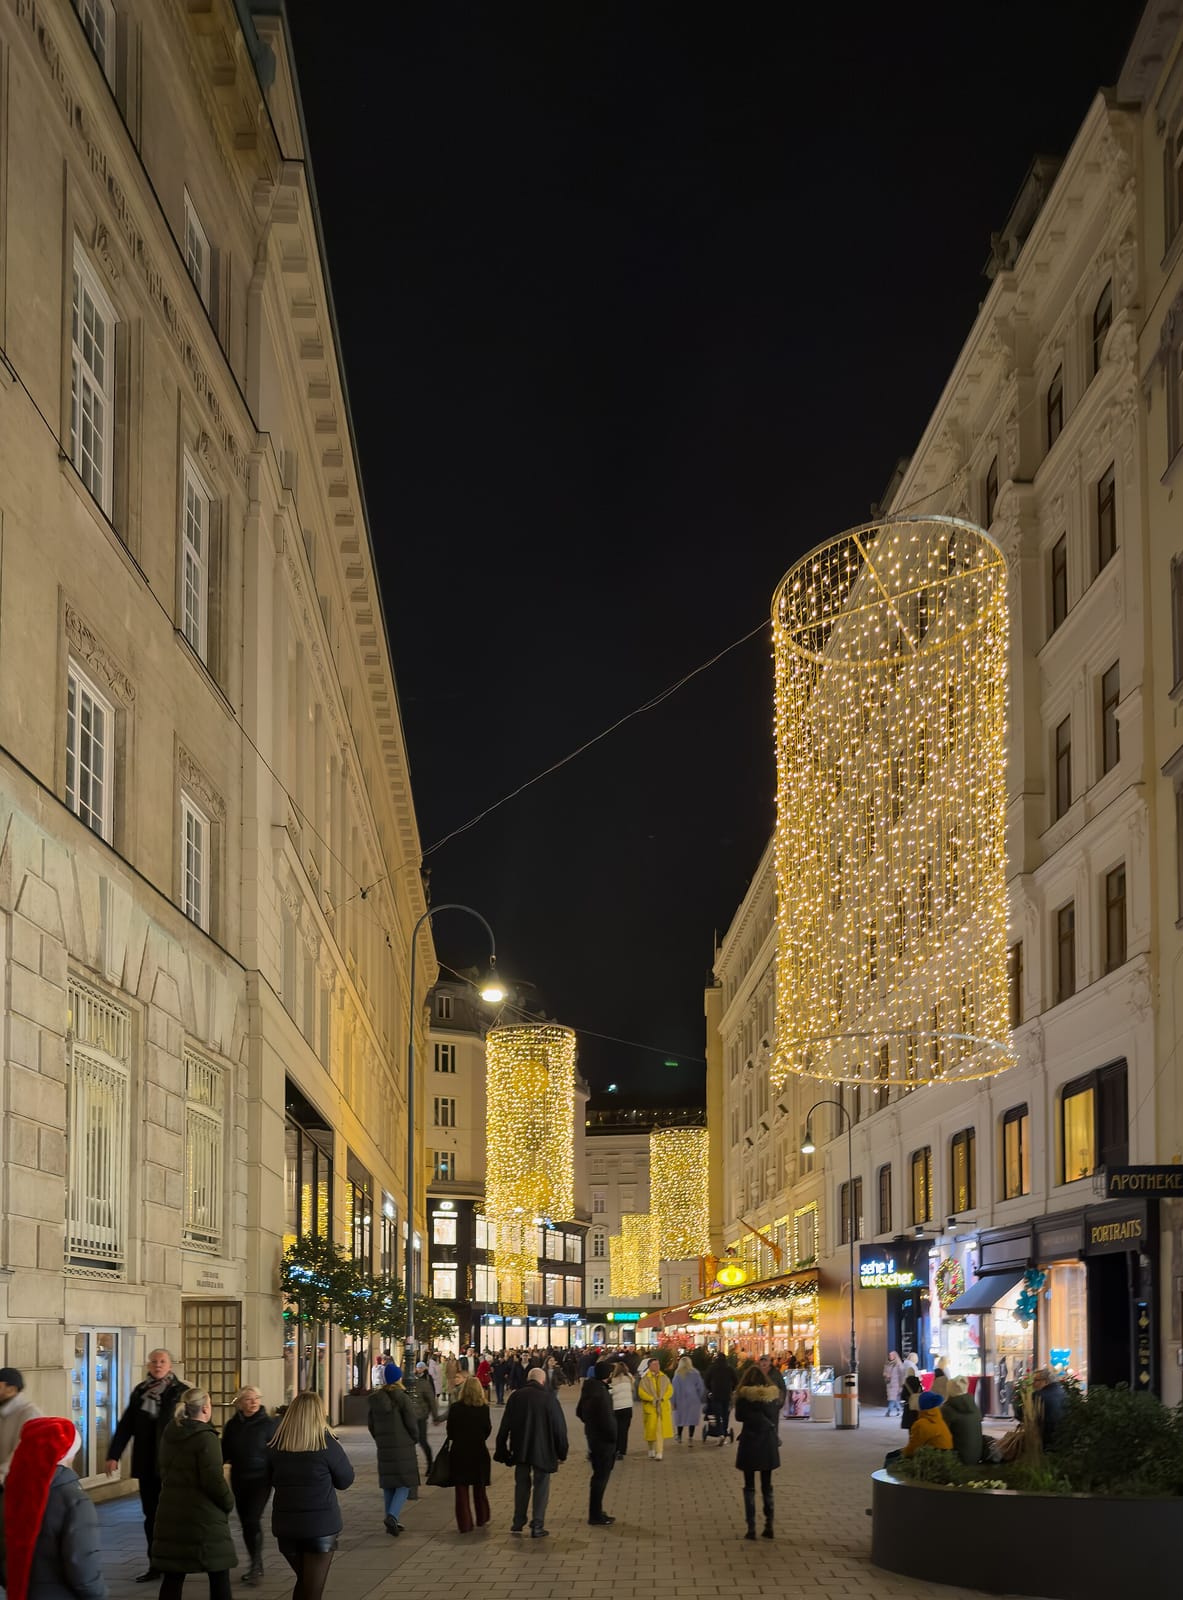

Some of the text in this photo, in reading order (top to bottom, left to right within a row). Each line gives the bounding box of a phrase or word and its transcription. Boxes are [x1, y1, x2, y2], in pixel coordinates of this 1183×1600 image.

[1110, 1174, 1183, 1190] APOTHEKE
[1091, 1219, 1142, 1243] PORTRAITS
[860, 1271, 914, 1287] wutscher
